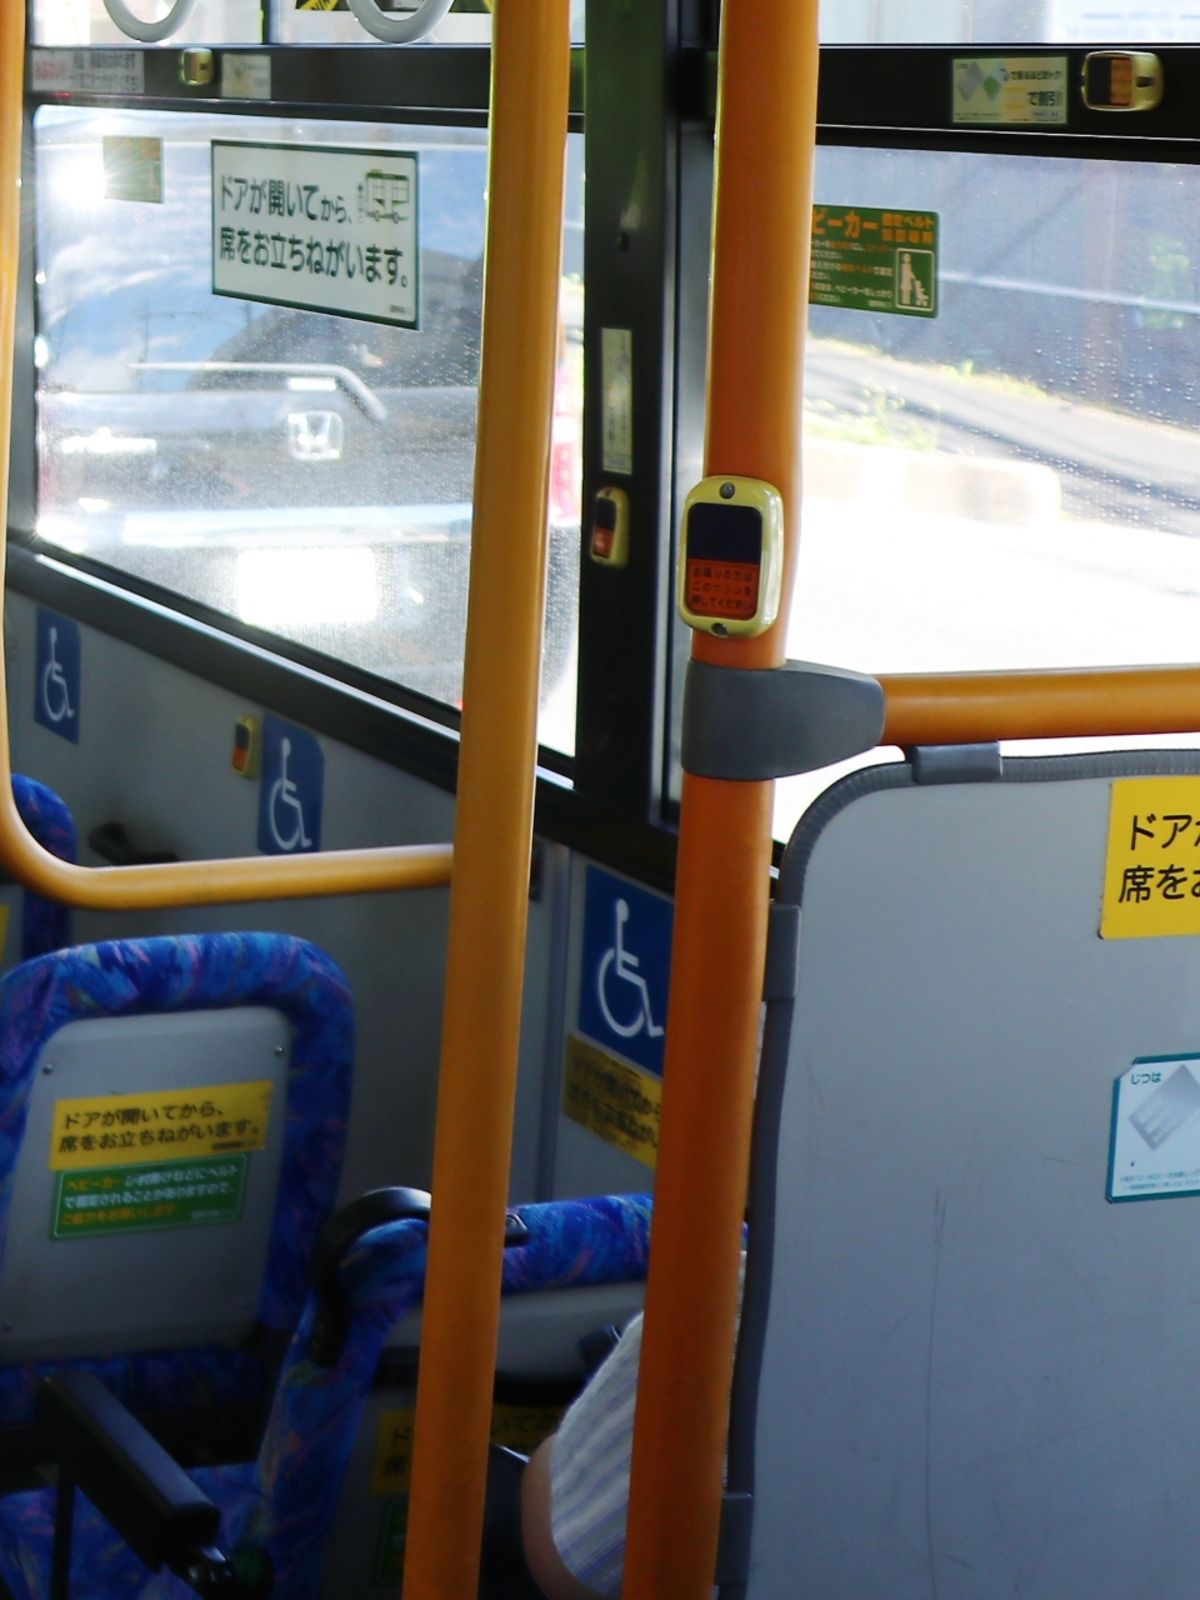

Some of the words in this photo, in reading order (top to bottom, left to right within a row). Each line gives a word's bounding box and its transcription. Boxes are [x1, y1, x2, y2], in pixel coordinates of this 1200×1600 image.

[221, 174, 352, 224] ドアが開いてから、
[220, 225, 408, 288] 席をお立ちねがいます。
[1130, 812, 1200, 851] ドア
[1130, 1071, 1162, 1086] じつは
[64, 1101, 224, 1130] ドアが開いてから、
[59, 1119, 260, 1153] 席をお立ちねがいます。
